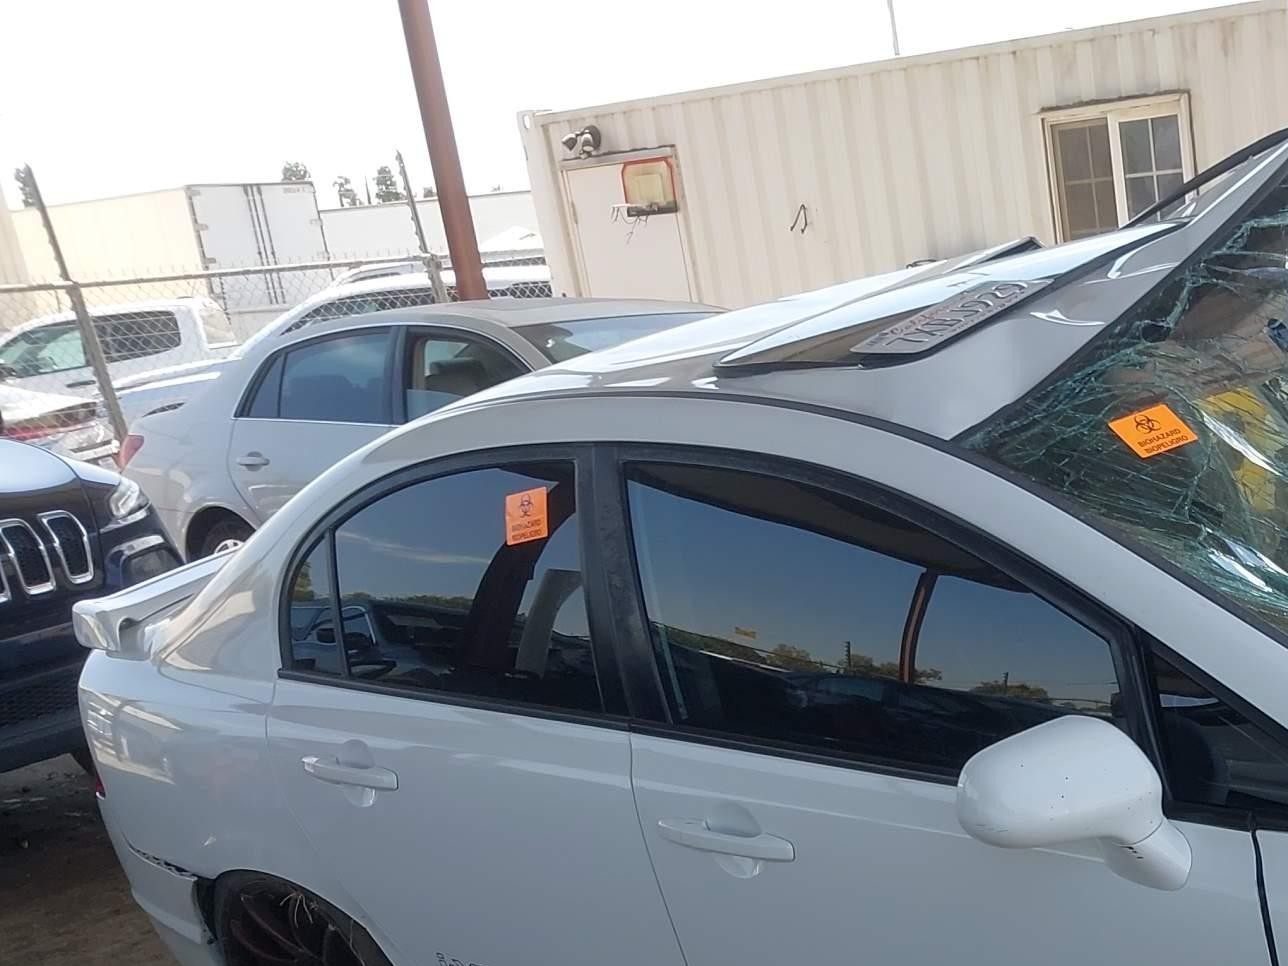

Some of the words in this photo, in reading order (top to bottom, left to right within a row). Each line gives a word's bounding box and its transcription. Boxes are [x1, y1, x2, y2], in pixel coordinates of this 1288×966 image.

[881, 282, 1028, 343] 7XBJ929
[1137, 428, 1181, 448] BIOHAZARD
[1144, 435, 1188, 454] BIOPELIGRO
